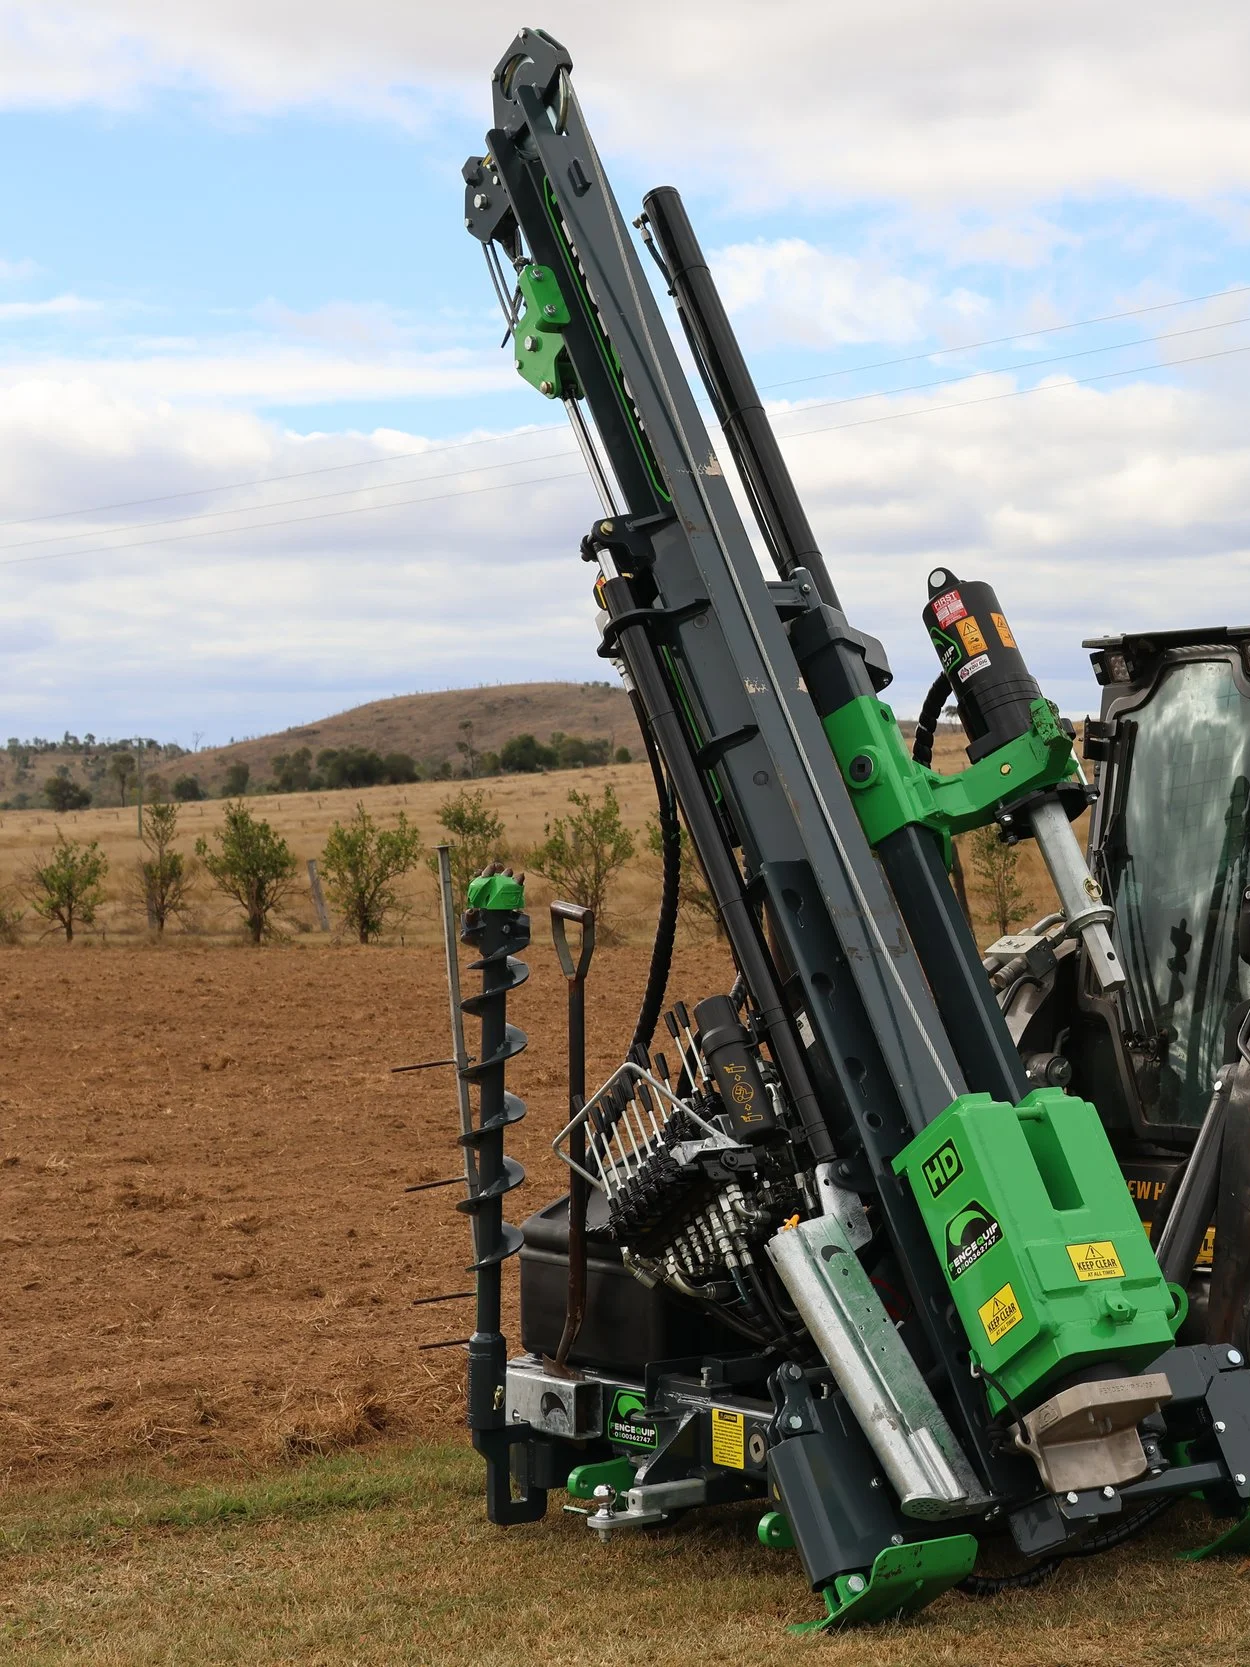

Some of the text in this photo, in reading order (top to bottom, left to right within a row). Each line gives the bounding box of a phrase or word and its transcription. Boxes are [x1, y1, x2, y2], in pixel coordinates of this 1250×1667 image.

[933, 591, 957, 609] FIRST
[924, 1146, 959, 1193] HD
[1127, 1180, 1151, 1200] EW
[948, 1222, 998, 1272] FENCEQUIP
[1076, 1258, 1117, 1271] KEEP CLEAR
[987, 1302, 1017, 1333] KEEP CLEAR
[610, 1421, 656, 1437] FENCEQUIP
